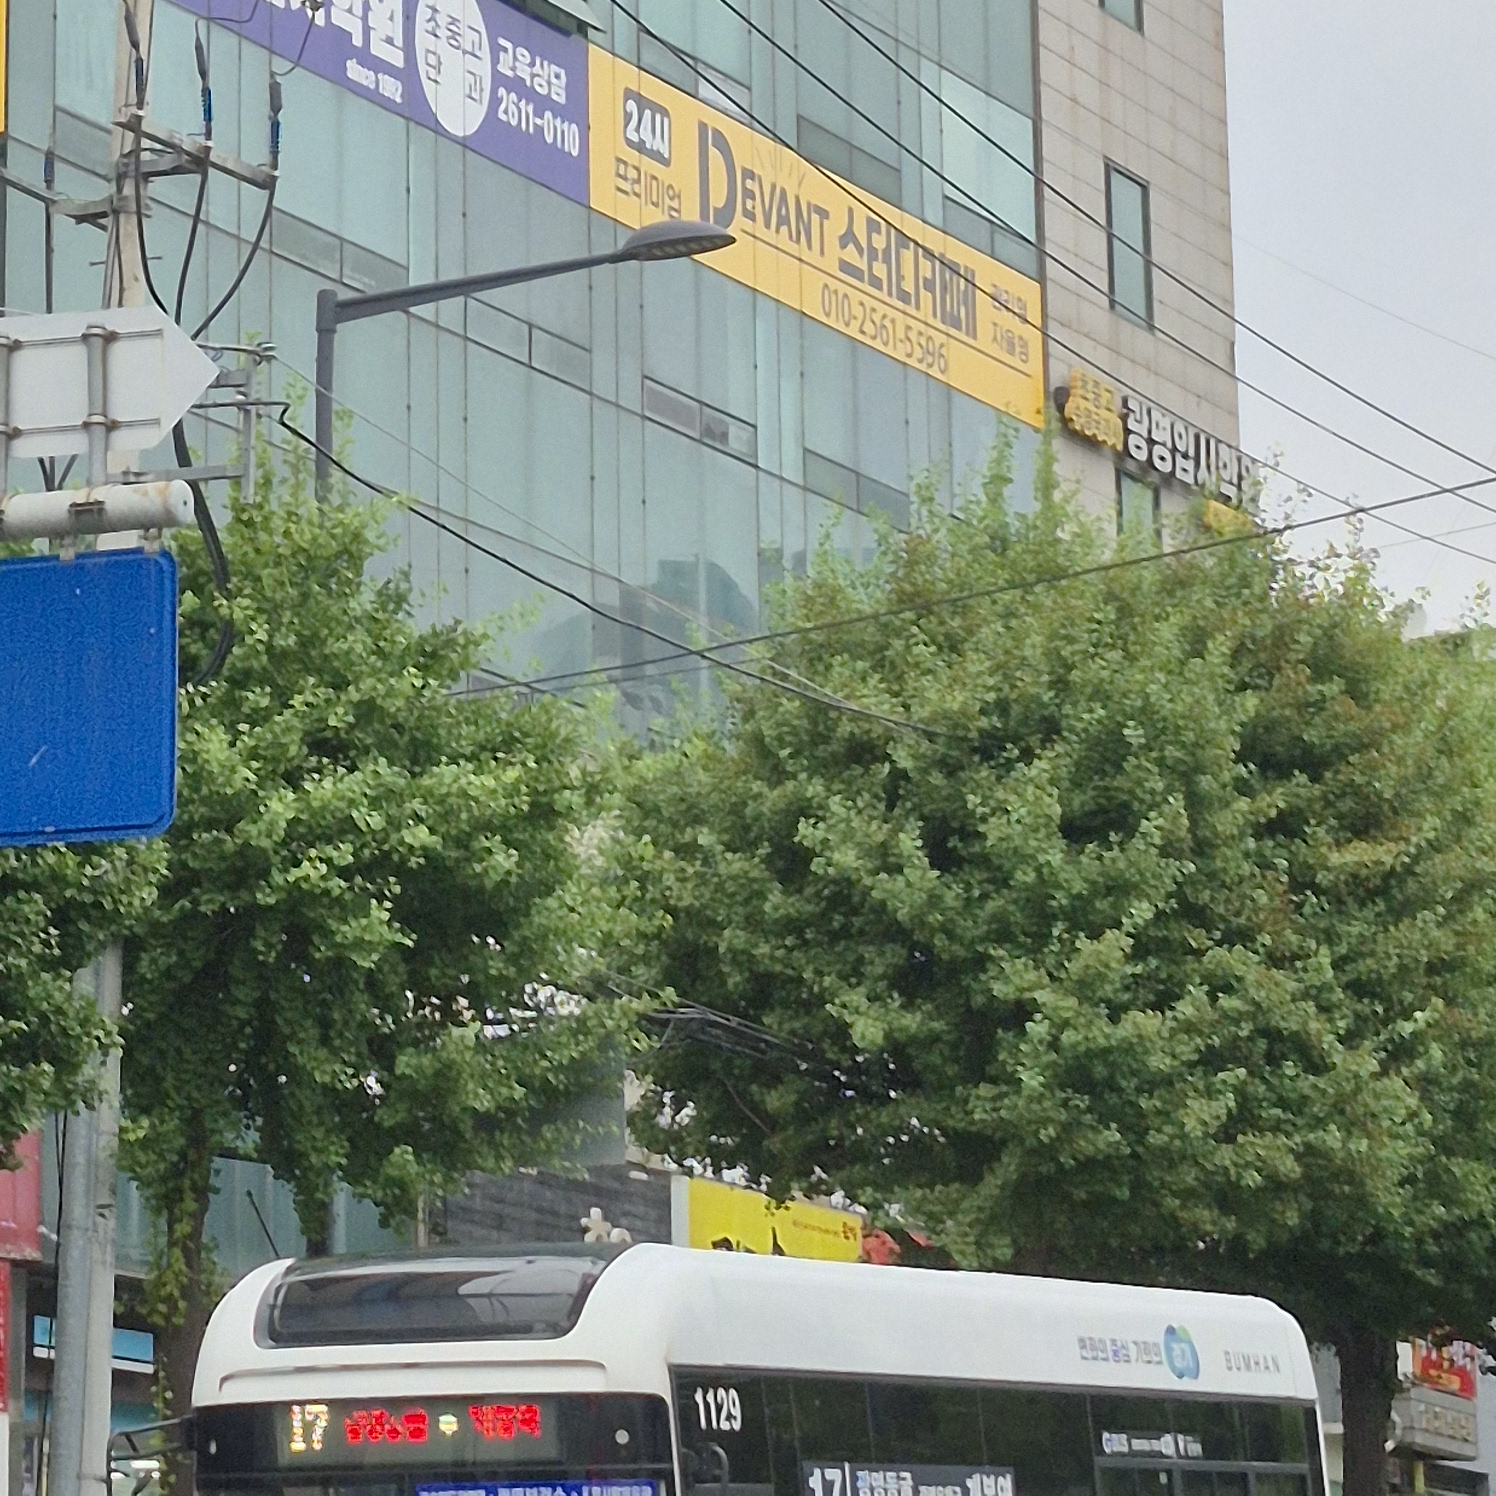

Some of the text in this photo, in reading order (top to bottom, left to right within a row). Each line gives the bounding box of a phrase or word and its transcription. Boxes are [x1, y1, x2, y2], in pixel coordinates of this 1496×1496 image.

[496, 35, 567, 106] 교육상담
[497, 86, 580, 158] 2611-0110
[624, 98, 671, 160] 24시
[697, 118, 978, 341] DEVANT 스터디카페
[820, 282, 949, 376] 010-2561-5596
[1223, 1349, 1282, 1374] BUMHAN
[694, 1386, 742, 1432] 1129
